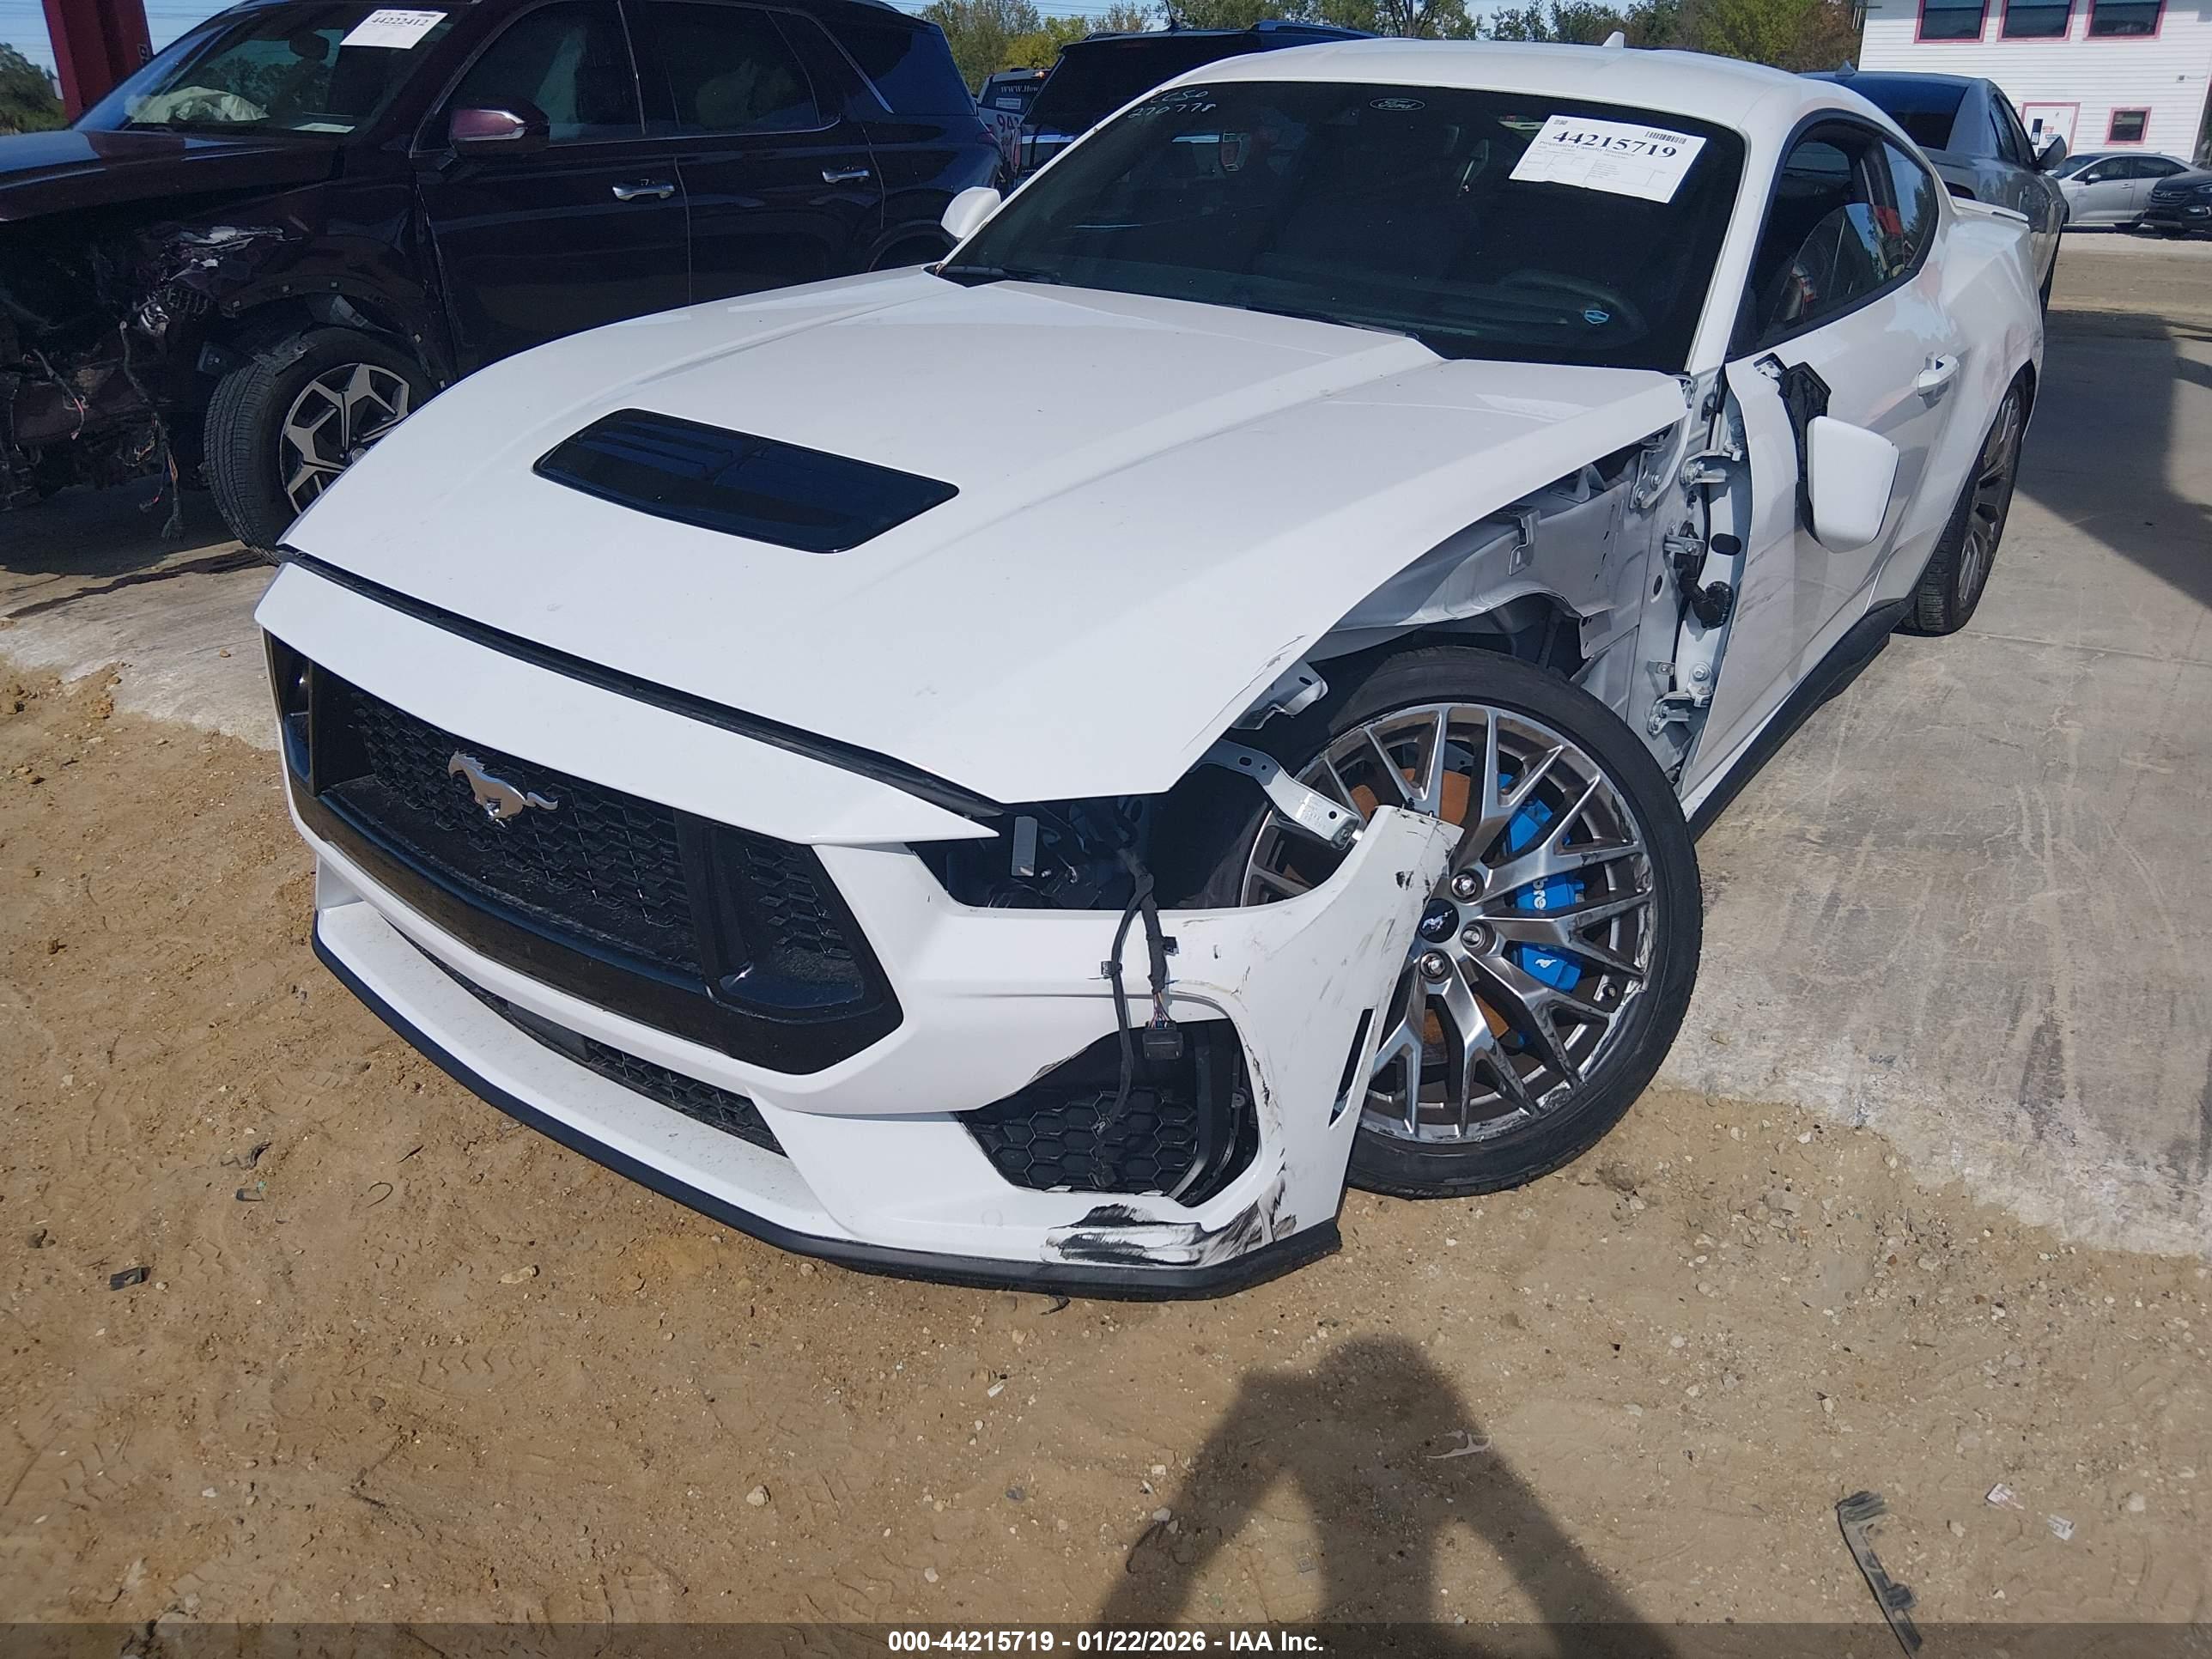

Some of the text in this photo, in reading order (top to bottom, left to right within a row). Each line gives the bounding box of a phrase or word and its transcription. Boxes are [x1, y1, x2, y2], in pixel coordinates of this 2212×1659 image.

[371, 16, 428, 27] 44222412
[1376, 99, 1419, 109] Ford
[1552, 130, 1678, 159] 44215719
[1533, 877, 1549, 910] bre
